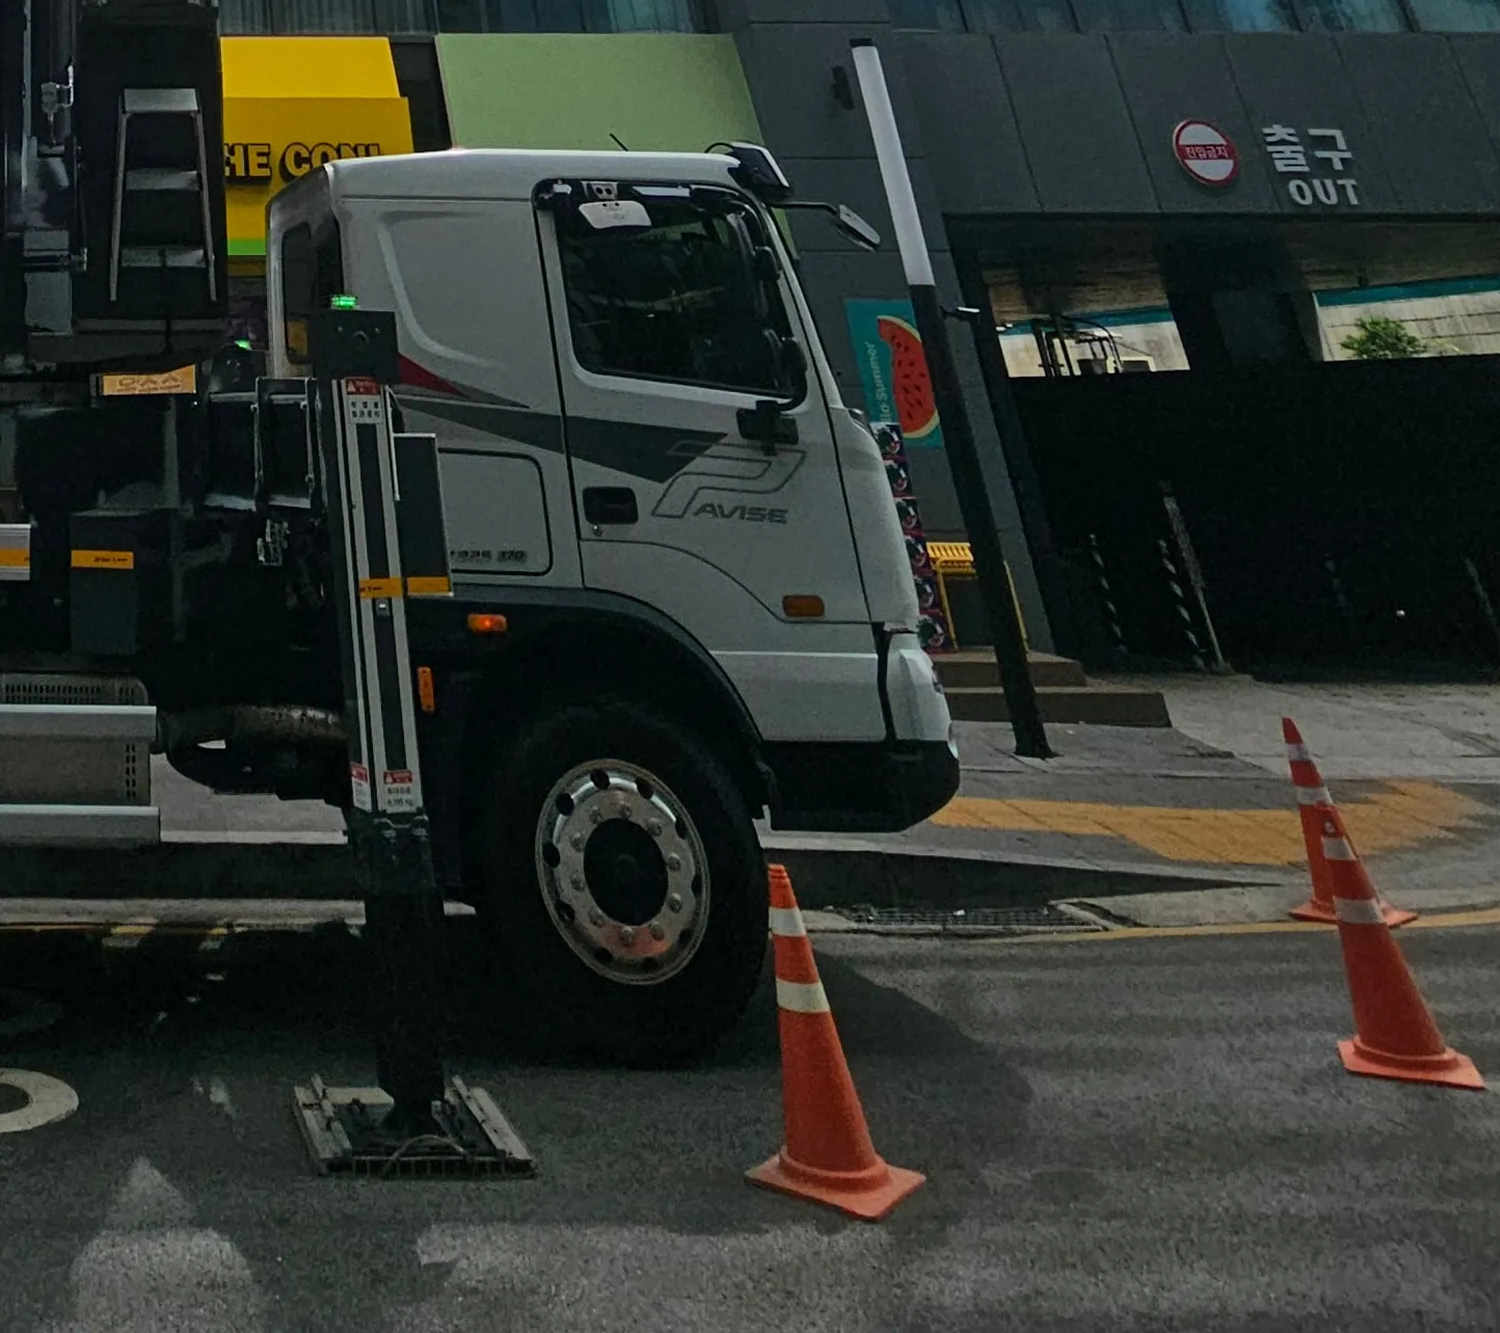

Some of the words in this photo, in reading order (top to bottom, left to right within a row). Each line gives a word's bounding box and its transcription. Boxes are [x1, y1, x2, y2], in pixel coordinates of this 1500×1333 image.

[224, 143, 272, 179] HE
[1261, 123, 1353, 173] 출구
[1287, 177, 1360, 206] OUT
